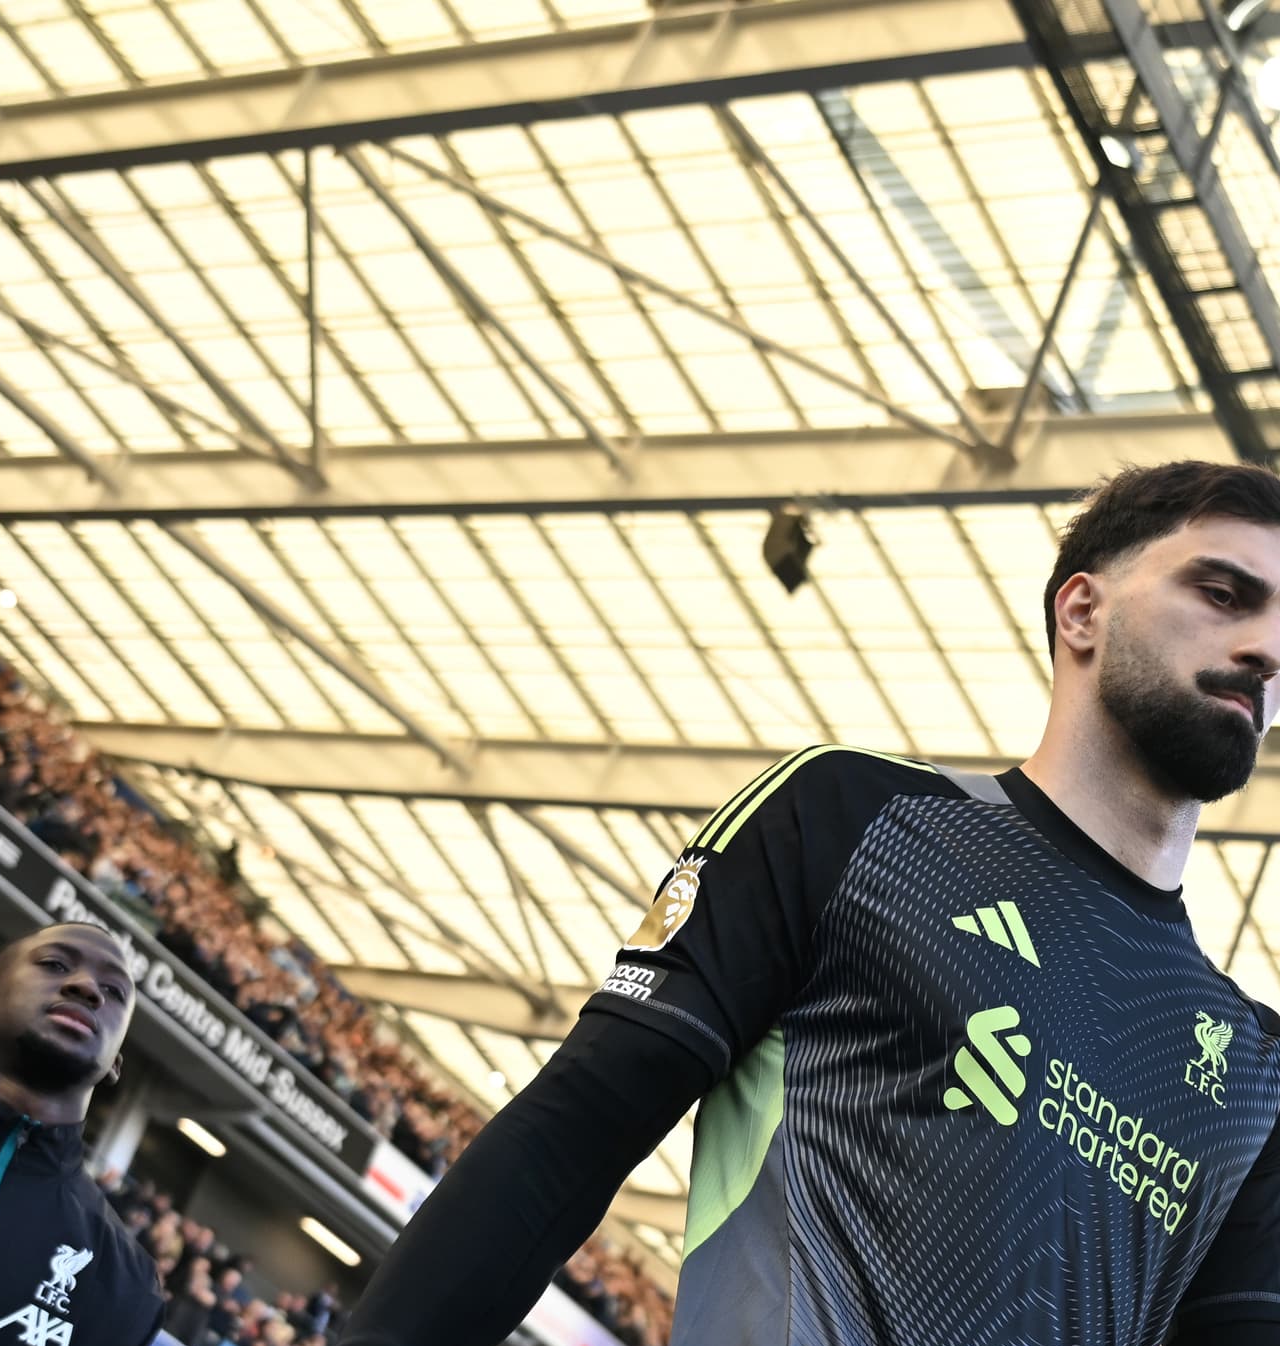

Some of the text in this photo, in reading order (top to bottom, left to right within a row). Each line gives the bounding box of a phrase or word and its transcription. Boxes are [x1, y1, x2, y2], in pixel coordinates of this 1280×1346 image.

[144, 957, 226, 1047] Centre
[218, 1033, 349, 1150] Mid-Sussex
[1038, 1097, 1188, 1236] chartered
[1046, 1057, 1200, 1194] standard
